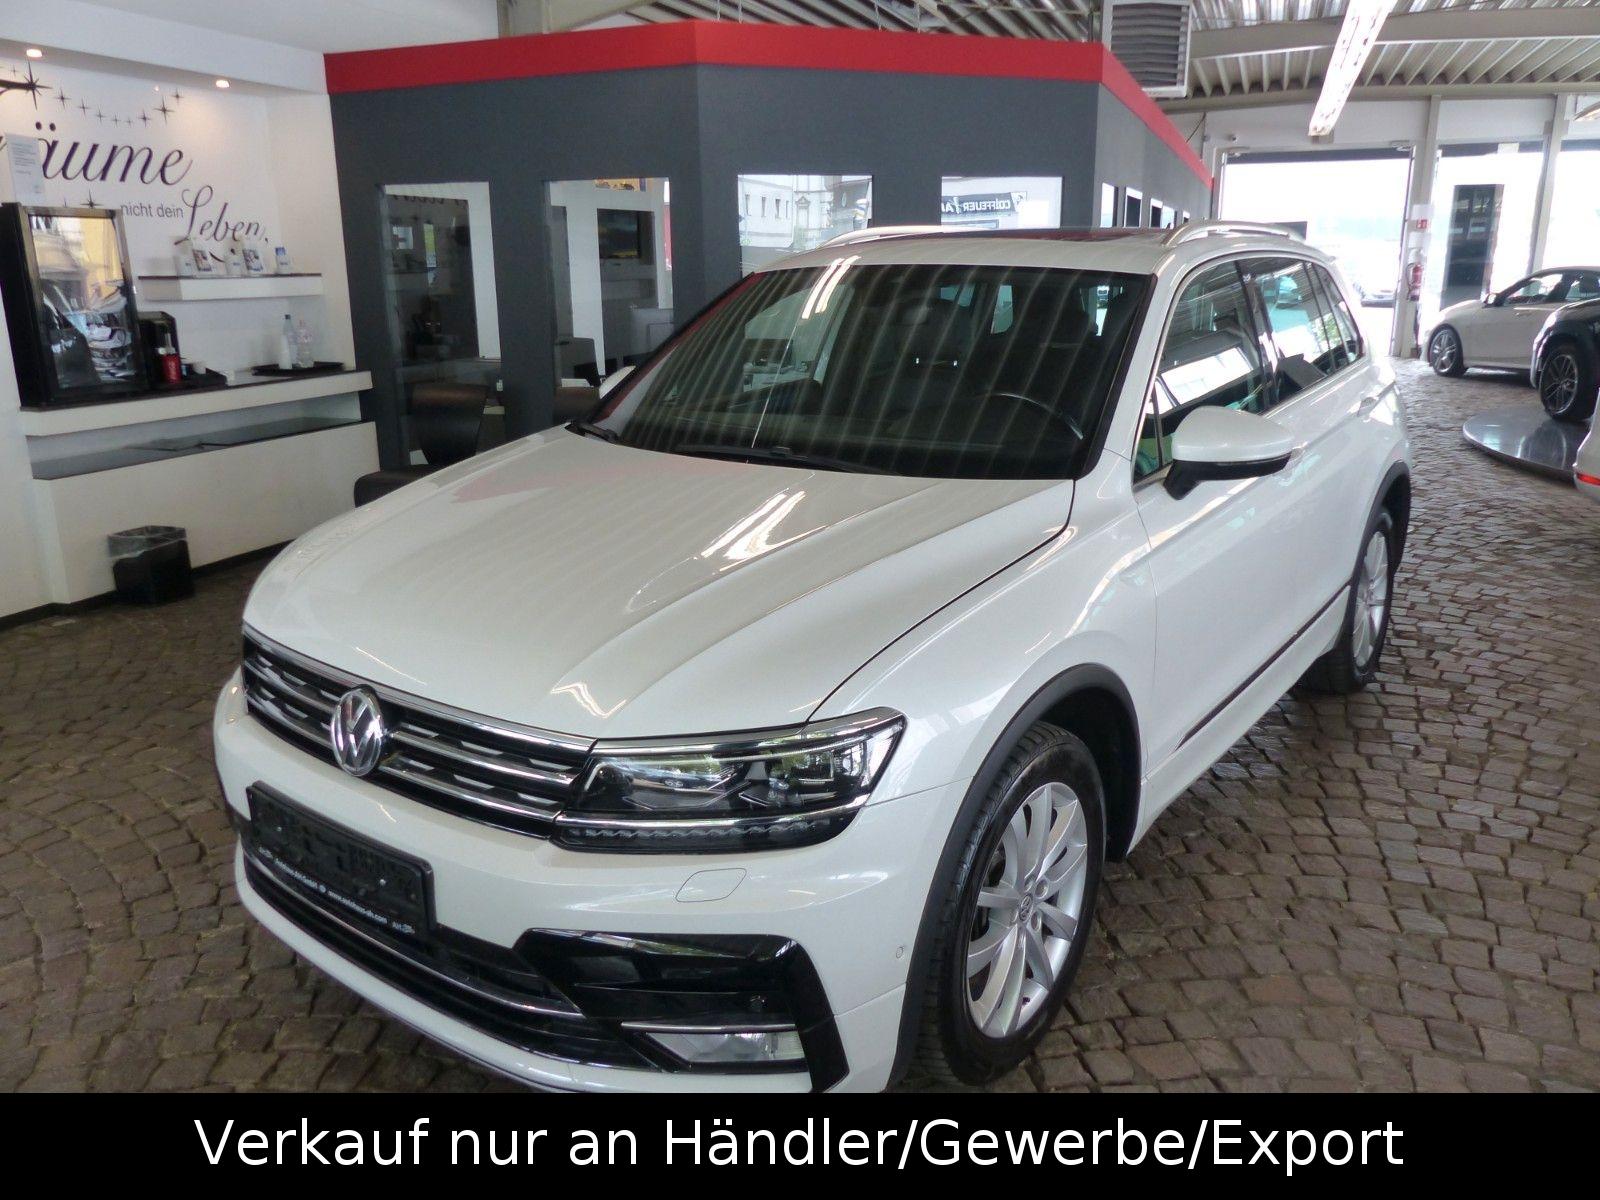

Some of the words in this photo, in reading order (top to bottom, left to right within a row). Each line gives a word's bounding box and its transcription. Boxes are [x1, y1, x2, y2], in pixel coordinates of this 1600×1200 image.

[0, 121, 193, 186] äume
[120, 203, 153, 217] nicht
[157, 206, 184, 218] dein
